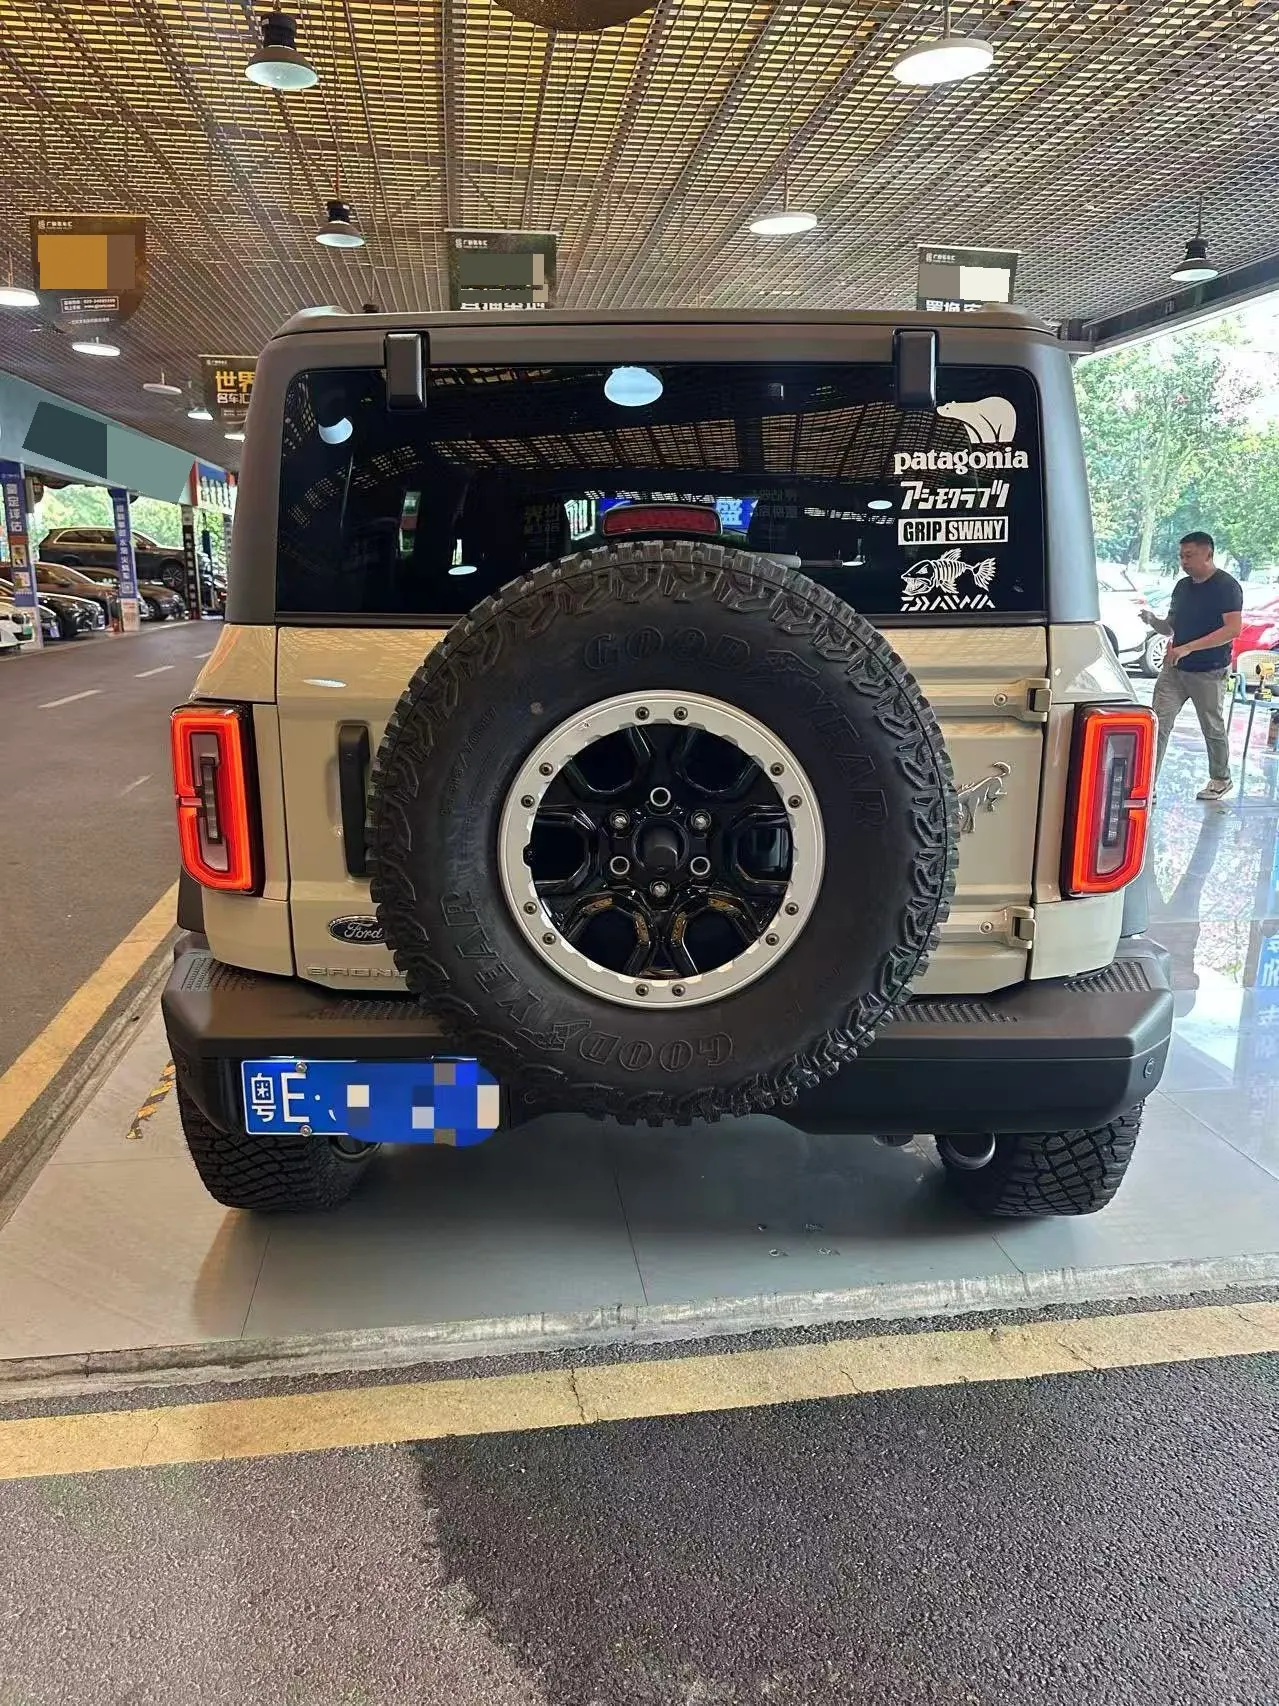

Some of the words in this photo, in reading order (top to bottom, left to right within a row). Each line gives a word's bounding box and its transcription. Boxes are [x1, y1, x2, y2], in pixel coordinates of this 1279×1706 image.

[215, 370, 256, 393] 世界
[893, 446, 1029, 475] patagonia
[903, 521, 943, 542] GRIP
[948, 520, 1003, 541] SWANY
[343, 921, 384, 939] Ford
